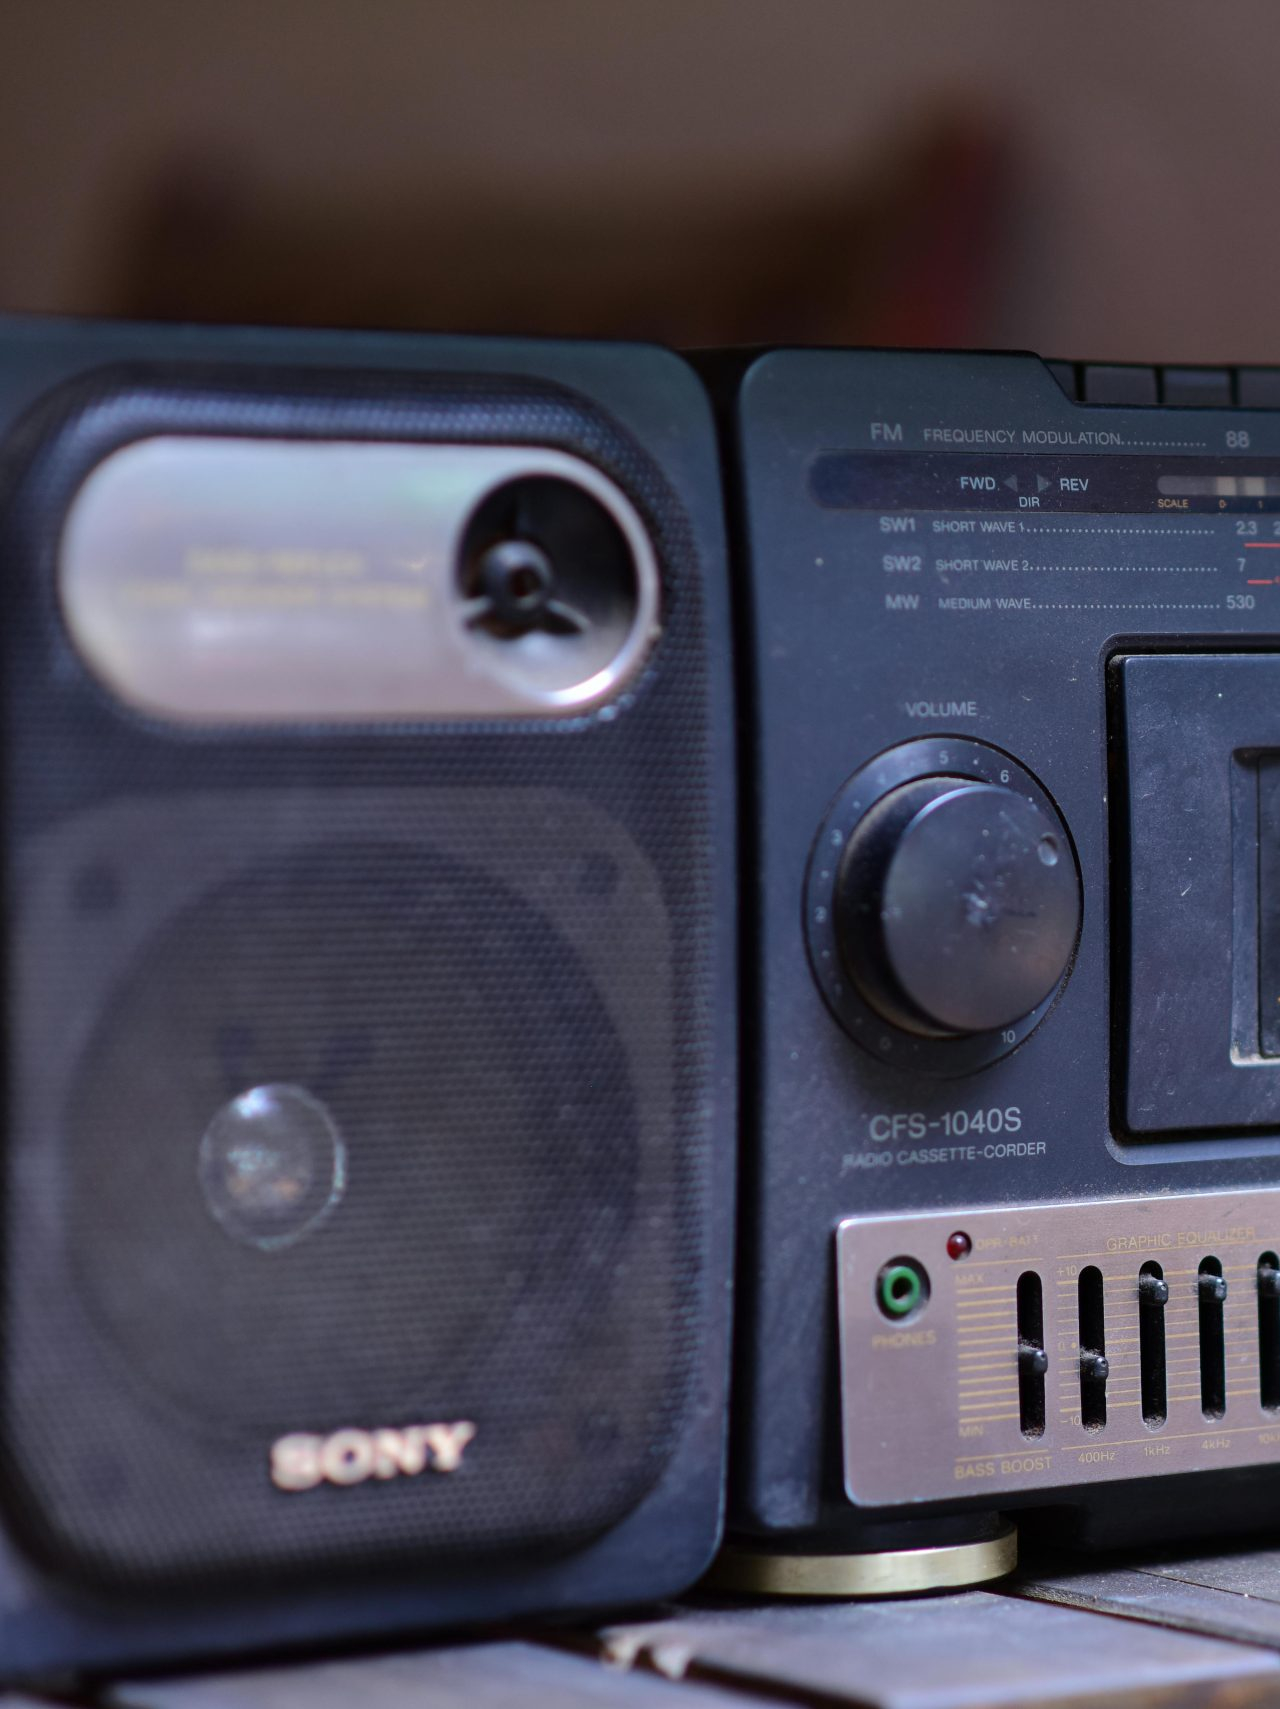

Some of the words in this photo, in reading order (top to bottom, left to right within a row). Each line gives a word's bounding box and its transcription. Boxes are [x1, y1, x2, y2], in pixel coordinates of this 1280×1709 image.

[870, 423, 904, 441] FM
[923, 428, 1016, 444] FREQUENCY
[1022, 430, 1121, 446] MODULATION
[1226, 430, 1250, 448] 88
[960, 476, 996, 491] FWD
[1060, 478, 1089, 492] REV
[1018, 497, 1041, 508] DIR
[1157, 499, 1189, 508] SCALE
[879, 516, 916, 533] SW1
[932, 520, 976, 533] SHORT
[980, 521, 1016, 533] WAVE
[1236, 521, 1258, 536] 2.3
[882, 555, 922, 572] SW2
[935, 559, 979, 572] SHORT
[982, 559, 1019, 571] WAVE
[1022, 560, 1030, 571] 2
[1237, 558, 1246, 572] 7
[885, 594, 920, 610] MW
[938, 598, 991, 609] MEDIUM
[996, 598, 1031, 609] WAVE
[1226, 594, 1255, 610] 530
[906, 702, 977, 718] VOLUME
[939, 751, 949, 765] 5
[1000, 770, 1009, 783] 6
[1000, 1030, 1015, 1044] 10
[869, 1107, 1021, 1142] CFS-1040S
[897, 1142, 1046, 1165] CASSETTE-CORDER
[1107, 1234, 1171, 1250] GRAPHIC
[1177, 1227, 1256, 1245] EQUALIZER
[1056, 1264, 1077, 1277] +10
[872, 1330, 937, 1347] PHONES
[959, 1425, 983, 1438] MIN
[1144, 1445, 1170, 1457] 1kHz
[1202, 1439, 1231, 1449] 4kHz
[270, 1420, 475, 1491] SONY
[1078, 1452, 1115, 1464] 400Hz
[954, 1462, 996, 1480] BASS
[1001, 1456, 1052, 1475] BOOST
